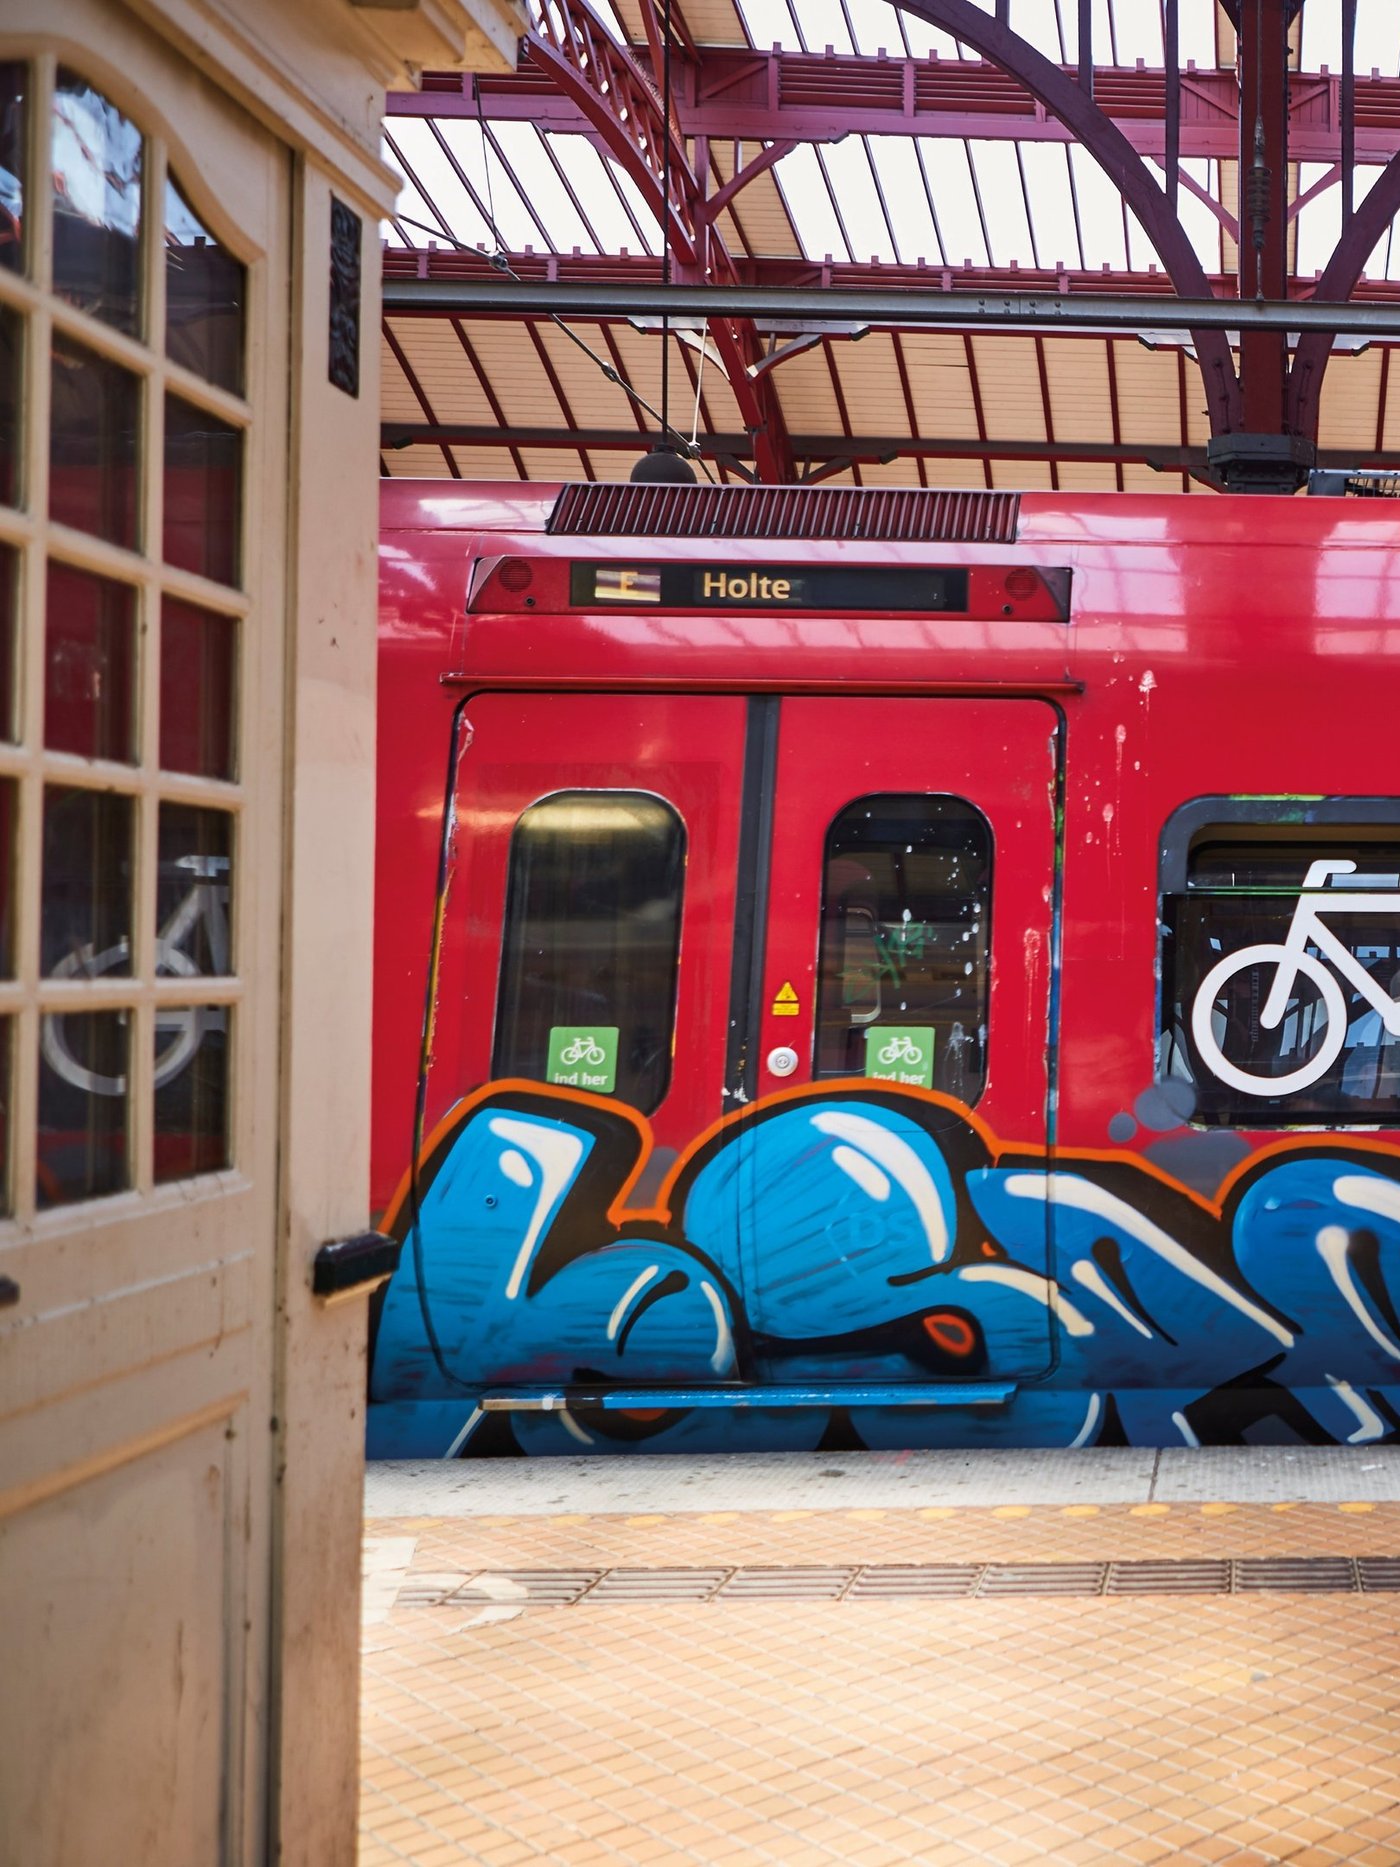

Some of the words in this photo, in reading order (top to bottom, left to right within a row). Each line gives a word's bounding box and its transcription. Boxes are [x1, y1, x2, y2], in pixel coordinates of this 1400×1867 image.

[620, 571, 638, 594] E
[703, 572, 791, 599] Holte
[553, 1072, 578, 1085] ind
[582, 1072, 608, 1086] her
